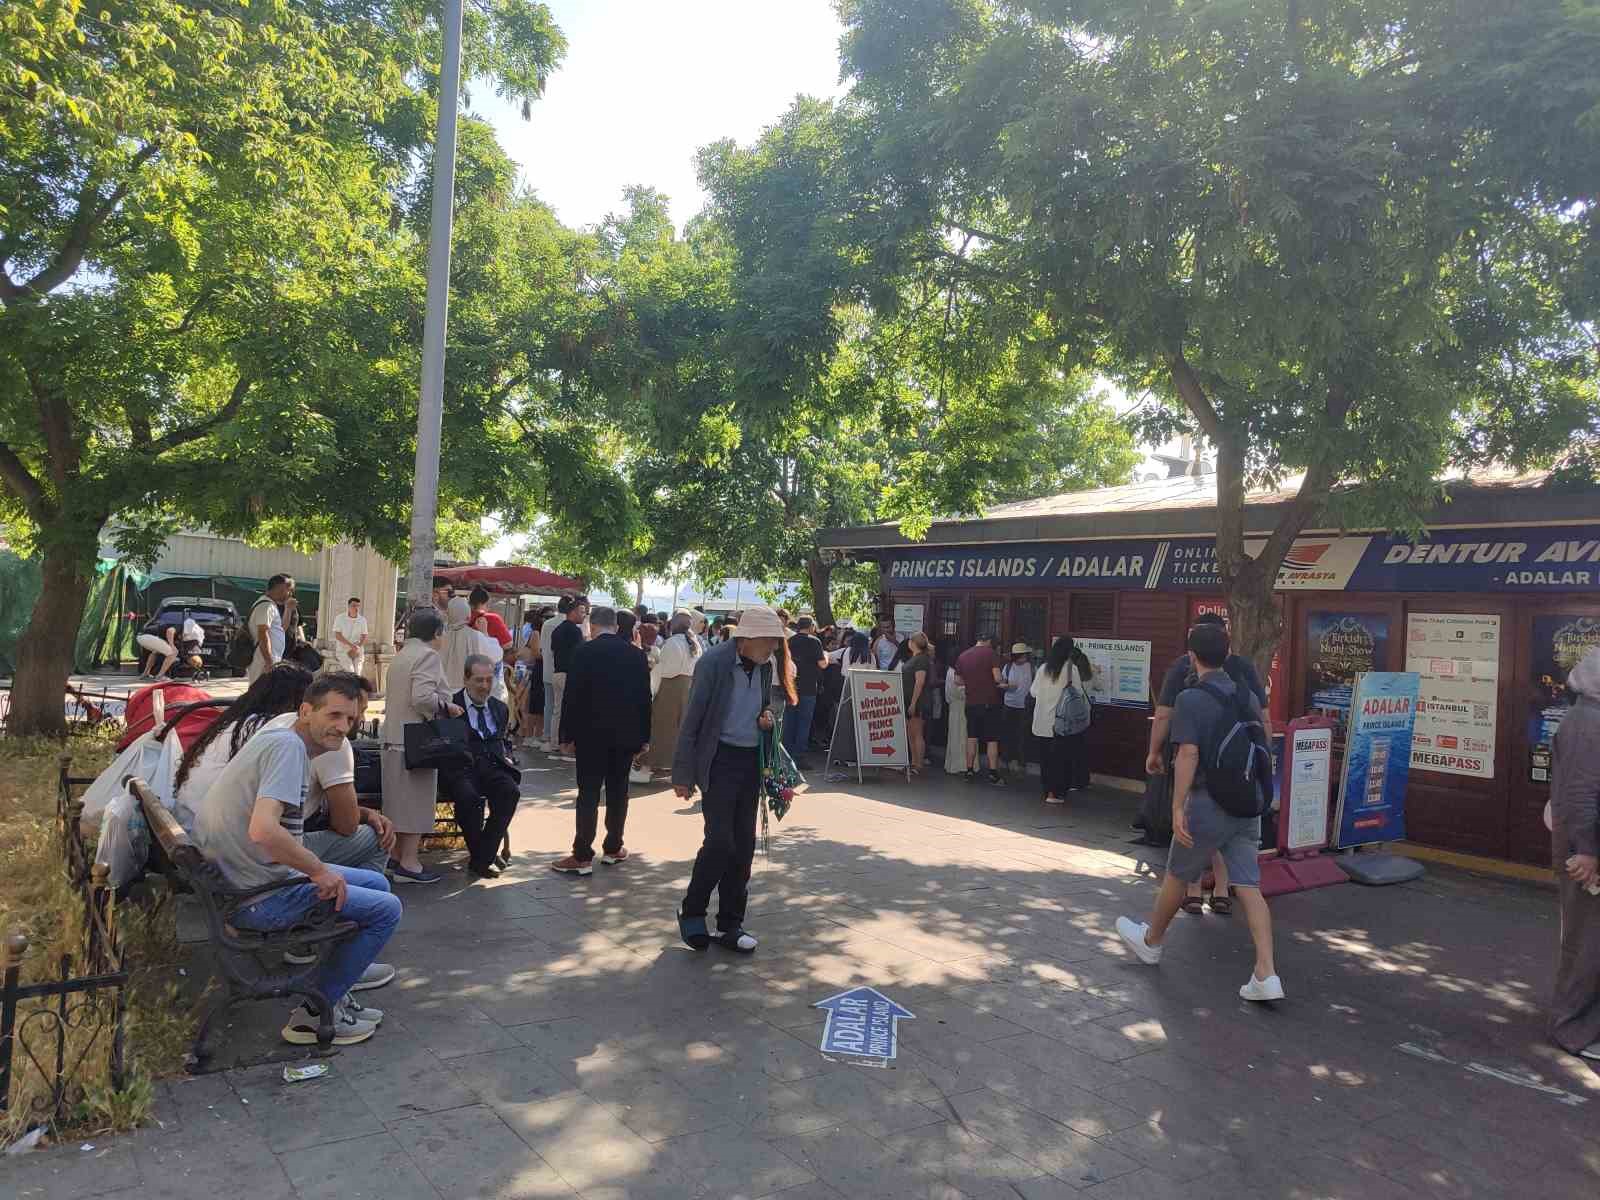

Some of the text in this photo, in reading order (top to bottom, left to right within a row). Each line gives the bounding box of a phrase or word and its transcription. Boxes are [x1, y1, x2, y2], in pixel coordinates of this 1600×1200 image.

[1174, 547, 1217, 558] ONLIN
[1384, 543, 1527, 563] DENTUR
[890, 559, 956, 577] PRINCES
[959, 558, 1037, 577] ISLANDS
[1056, 555, 1144, 577] ADALAR
[1173, 562, 1220, 573] TICKE
[1172, 576, 1223, 585] COLLECTIO
[1505, 571, 1590, 585] ADALAR
[1198, 605, 1228, 616] Onlin
[1363, 697, 1409, 715] ADALAR
[868, 719, 892, 730] PRINCE
[1296, 740, 1326, 751] MEGAPASS
[1413, 751, 1481, 771] MEGAPASS
[832, 997, 868, 1052] ADALAR
[869, 1000, 890, 1055] PRINCE ISLAND
